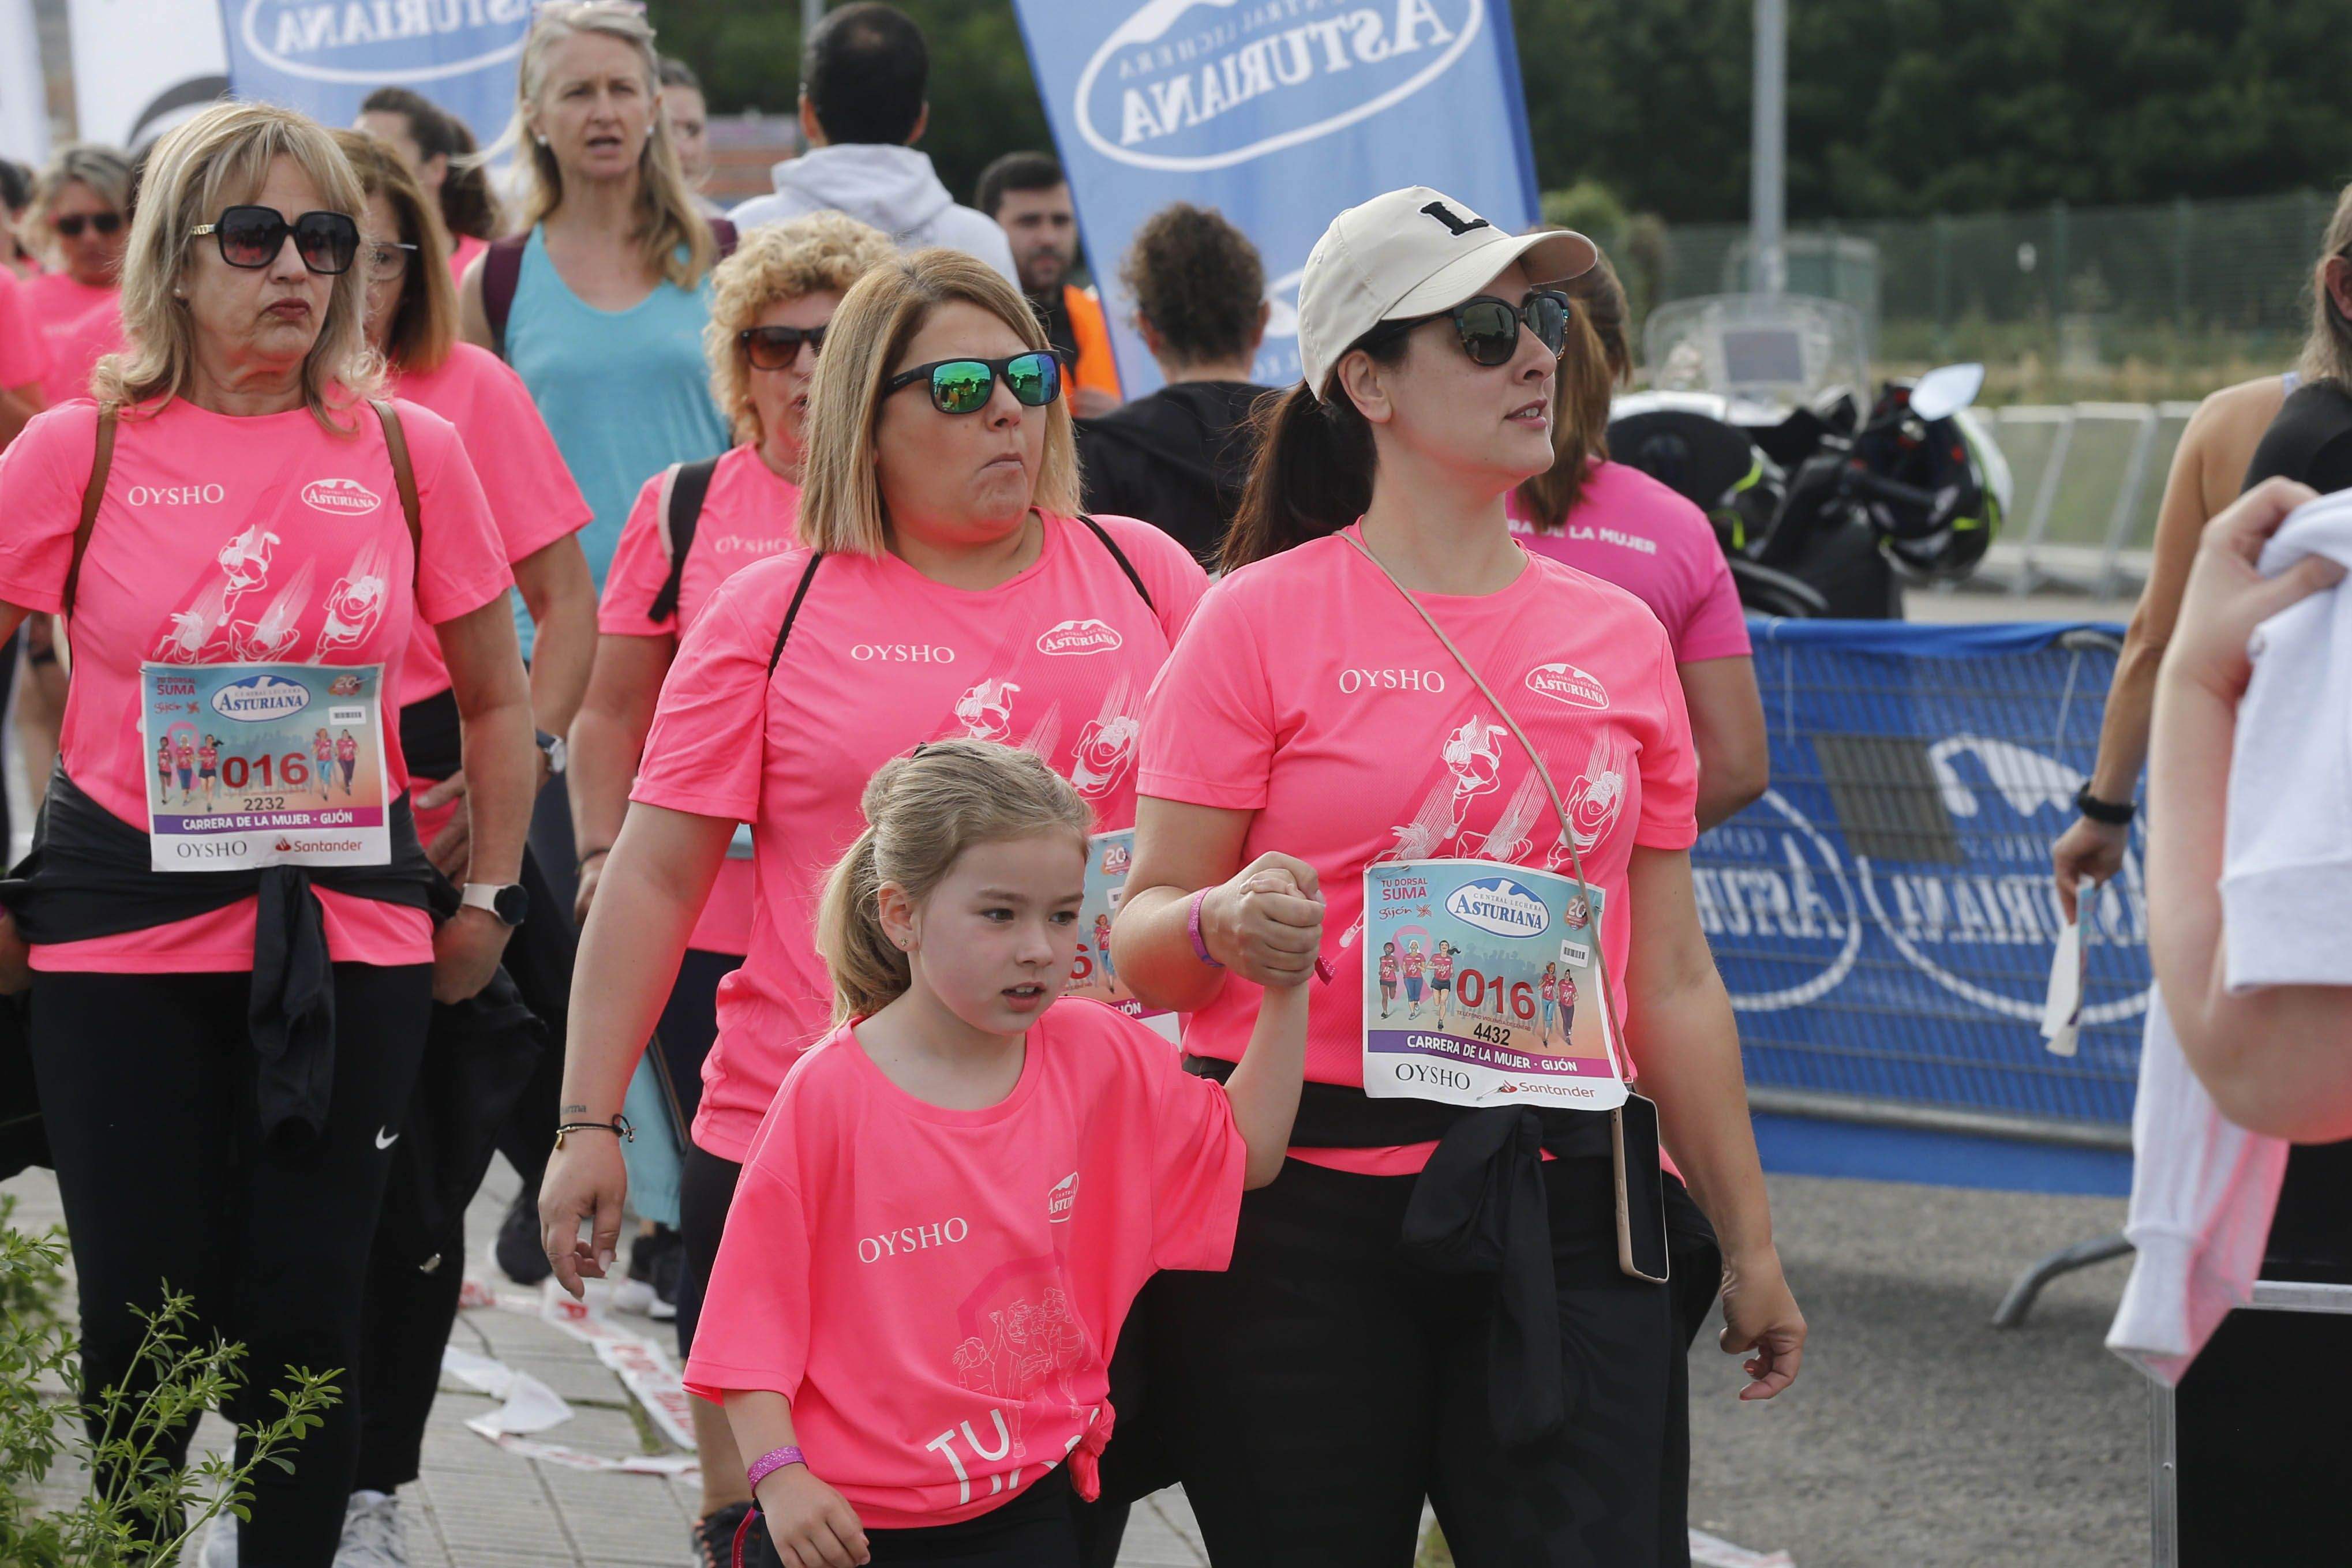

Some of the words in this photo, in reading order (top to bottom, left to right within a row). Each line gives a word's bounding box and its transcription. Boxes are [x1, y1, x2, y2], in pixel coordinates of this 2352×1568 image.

[1420, 201, 1489, 236] L
[128, 483, 224, 506] OYSHO
[309, 488, 376, 508] ASTURIANA
[714, 535, 792, 554] OYSHO
[1569, 525, 1594, 540] LA
[1599, 527, 1657, 554] MUJER
[1046, 633, 1117, 651] ASTURIANA
[851, 644, 955, 664] OYSHO
[157, 685, 196, 696] SUMA
[1339, 669, 1445, 693] OYSHO
[1534, 674, 1605, 706] ASTURIANA
[219, 693, 303, 711] ASTURIANA
[222, 752, 309, 789] 016
[244, 797, 285, 812] 2232
[182, 816, 231, 831] CARRERA
[237, 815, 251, 827] DE
[254, 815, 269, 827] LA
[272, 813, 311, 826] MUJER
[320, 809, 353, 825] GIJÓN
[177, 840, 247, 858] OYSHO
[294, 841, 362, 853] Santander
[1105, 847, 1126, 866] 20
[1381, 880, 1392, 888] TU
[1395, 877, 1428, 887] DORSAL
[1382, 887, 1427, 901] SUMA
[1473, 893, 1508, 905] CENTRAL
[1510, 899, 1542, 912] LECHERA
[1379, 905, 1413, 920] gijón
[1454, 894, 1543, 930] ASTURIANA
[1456, 968, 1536, 1021] 016
[1474, 1022, 1511, 1046] 4432
[1407, 1035, 1460, 1055] CARRERA
[1462, 1045, 1475, 1058] DE
[1478, 1048, 1491, 1062] LA
[1494, 1051, 1531, 1070] MUJER
[1541, 1057, 1578, 1072] GIJÓN
[1395, 1063, 1471, 1090] OYSHO
[1519, 1082, 1596, 1098] Santander
[857, 1217, 968, 1263] OYSHO
[926, 1408, 1010, 1505] TU
